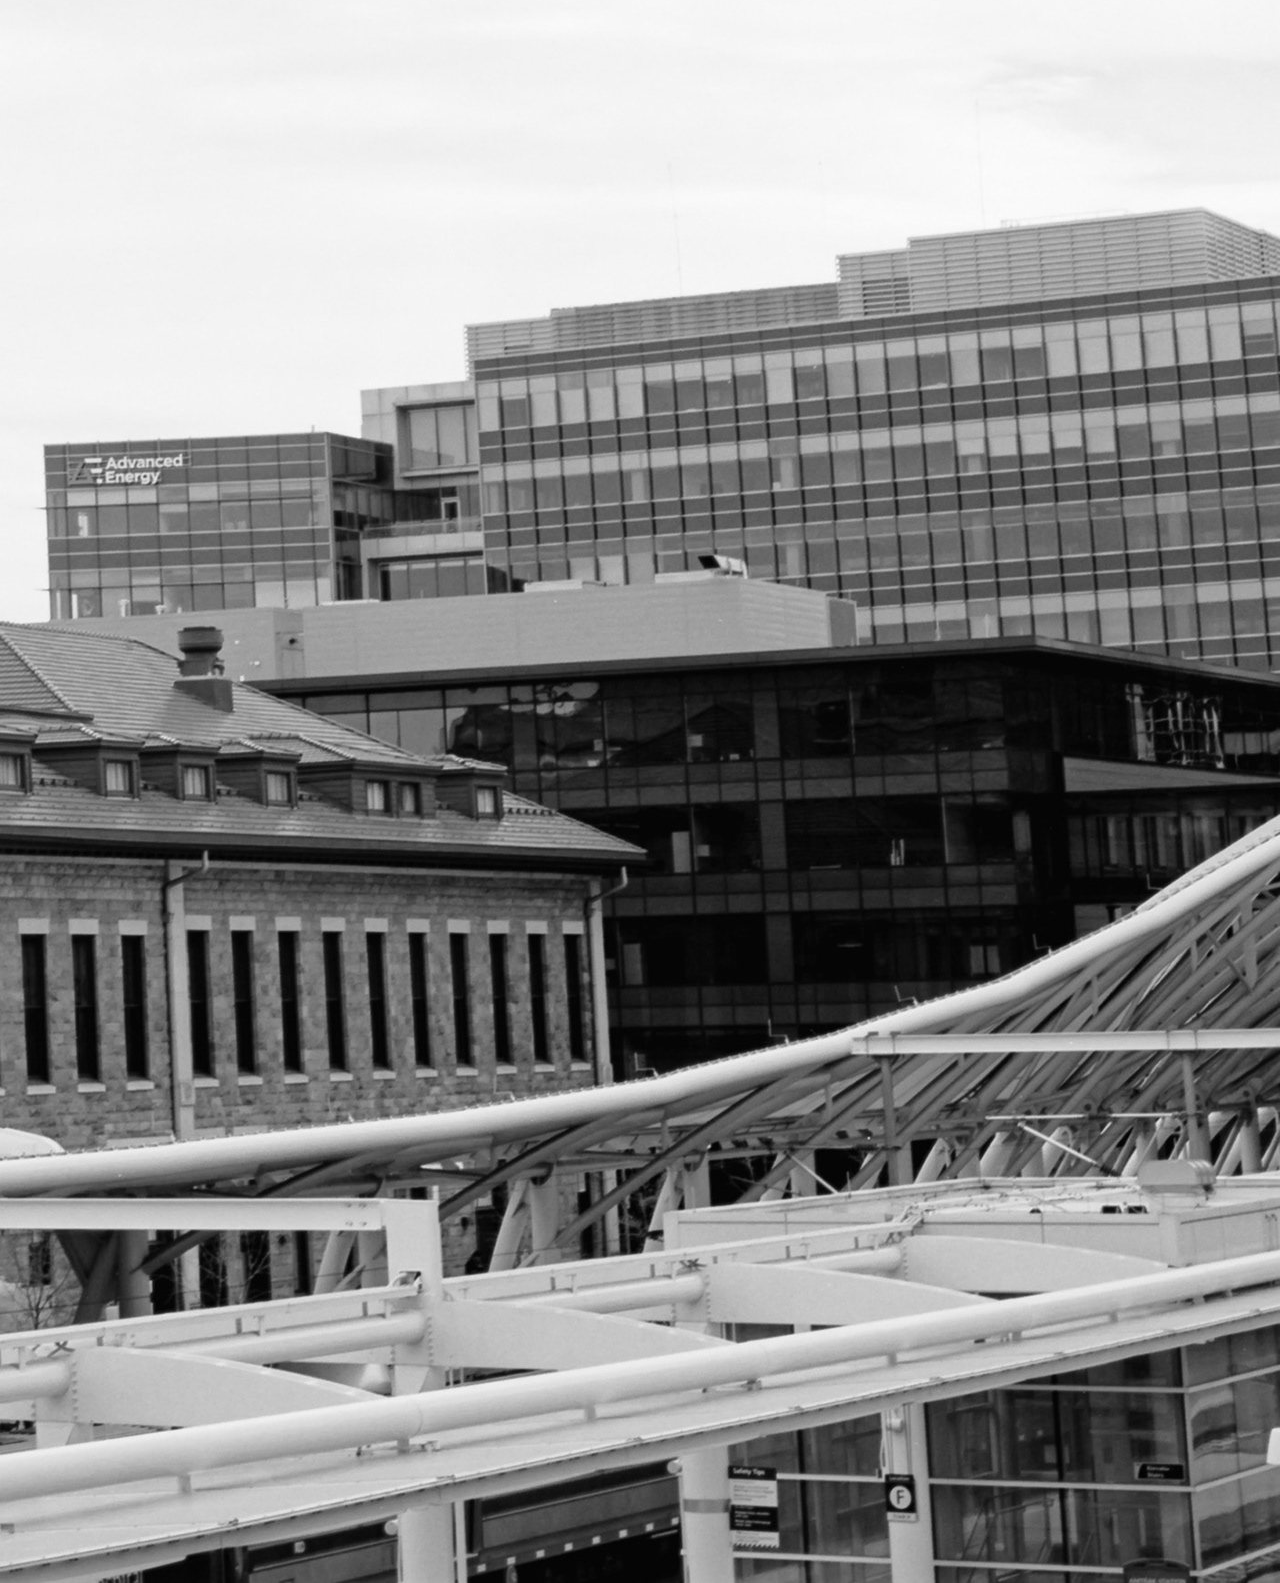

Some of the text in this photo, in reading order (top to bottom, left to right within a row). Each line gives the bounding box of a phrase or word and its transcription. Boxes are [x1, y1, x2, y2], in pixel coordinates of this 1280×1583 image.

[105, 453, 184, 470] Advanced
[104, 470, 161, 485] Energy
[896, 1489, 905, 1505] F
